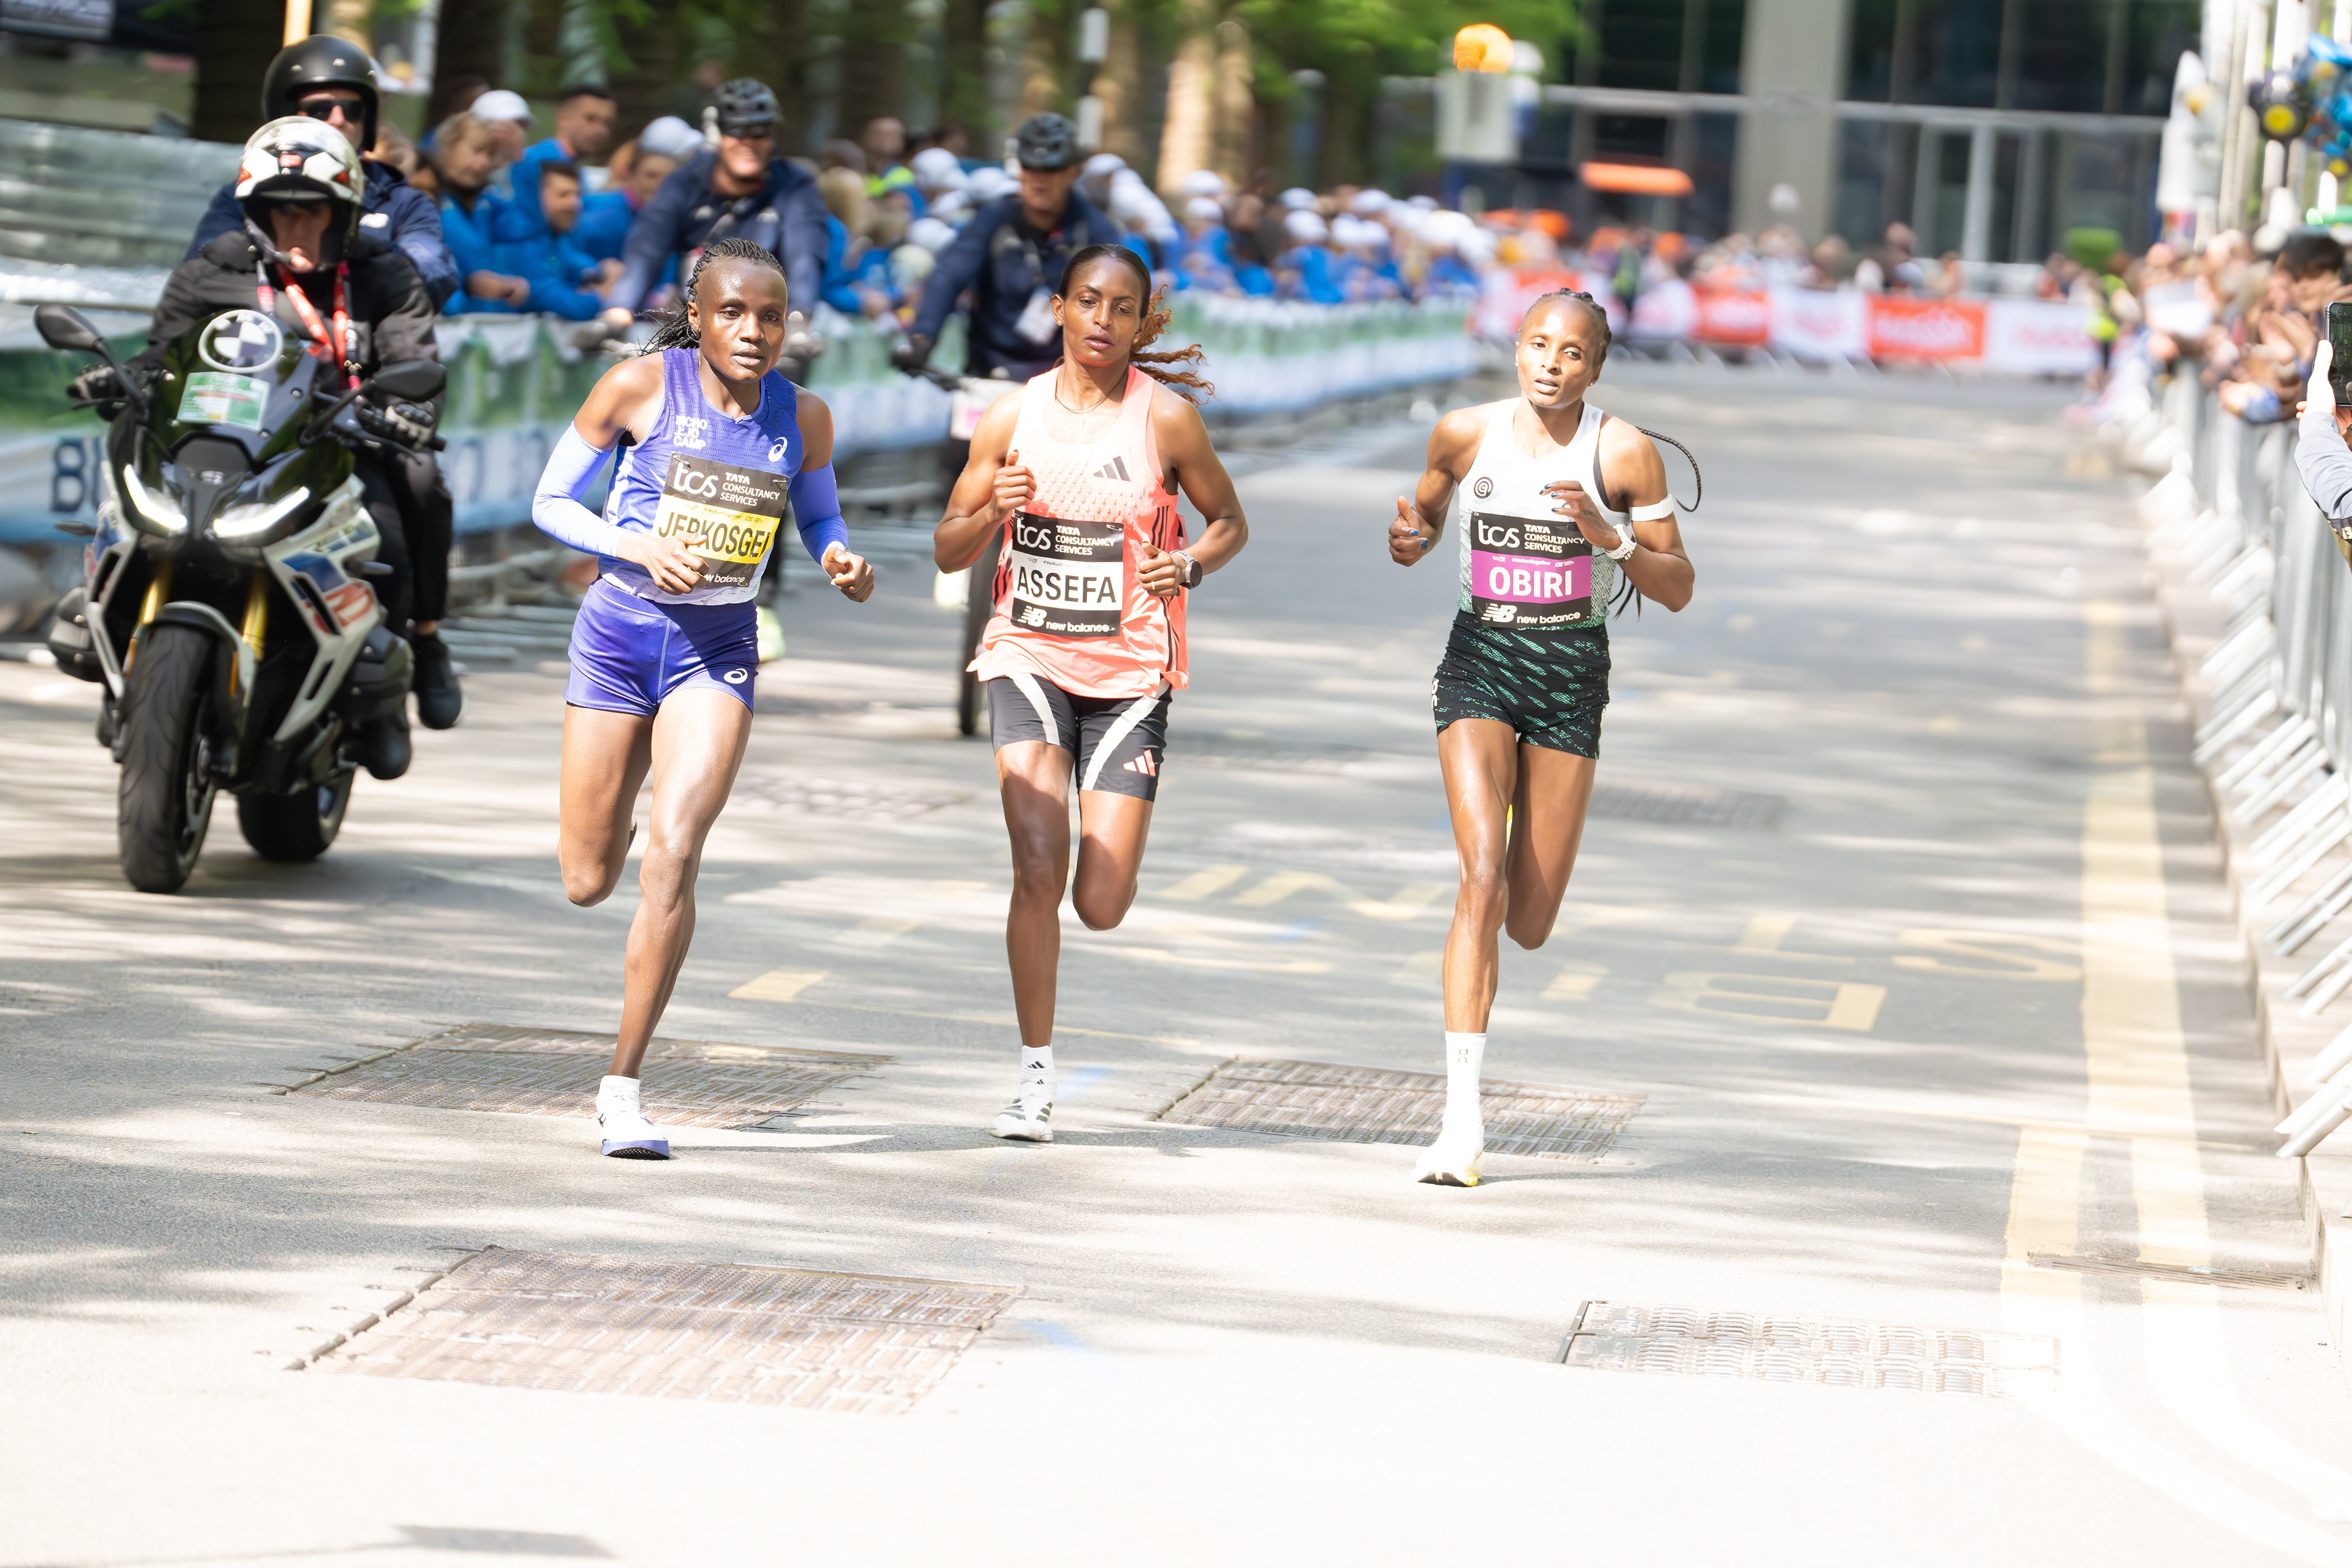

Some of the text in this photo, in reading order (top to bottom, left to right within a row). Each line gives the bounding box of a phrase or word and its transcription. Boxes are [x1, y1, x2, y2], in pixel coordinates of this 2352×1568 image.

[673, 435, 706, 450] CAMP
[673, 462, 719, 497] tcs
[725, 472, 750, 485] TATA
[722, 483, 780, 500] CONSULTANCY
[720, 492, 758, 507] SERVICES
[704, 508, 742, 519] #WeRunTogether
[1017, 518, 1051, 550] tcs
[1056, 525, 1080, 536] TATA
[1478, 519, 1520, 548] tcs
[1524, 524, 1551, 534] TATA
[1055, 535, 1116, 546] CONSULTANCY
[1524, 533, 1585, 545] CONSULTANCY
[1055, 545, 1093, 556] SERVICES
[1524, 541, 1562, 554] SERVICES
[714, 574, 745, 584] balance
[1017, 565, 1117, 603] ASSEFA
[1489, 566, 1572, 598] OBIRI
[1517, 612, 1581, 624] new balance
[1046, 620, 1110, 632] new balance
